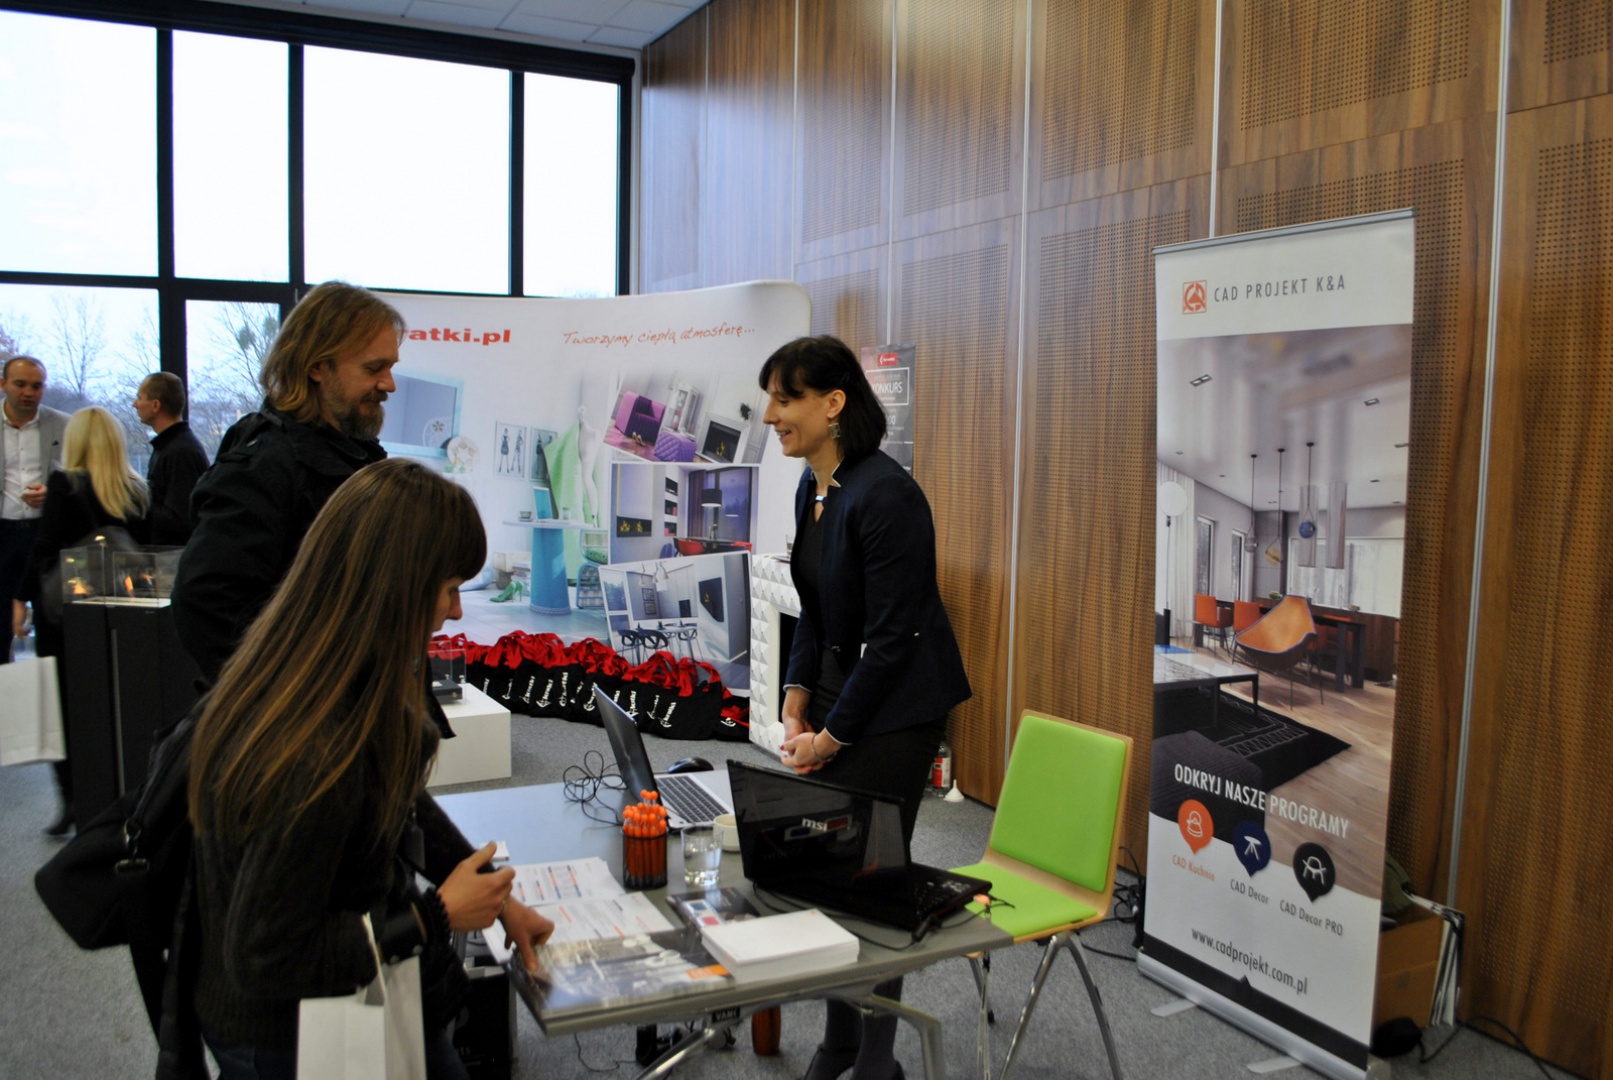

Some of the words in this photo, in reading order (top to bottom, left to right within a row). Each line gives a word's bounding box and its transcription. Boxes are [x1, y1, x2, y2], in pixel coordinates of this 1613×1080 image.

[1214, 286, 1238, 302] CAD
[1246, 278, 1308, 299] PROJEKT
[1316, 275, 1345, 292] K&A
[405, 328, 511, 346] atki.pl
[563, 331, 633, 348] Tworzymy
[1174, 763, 1221, 796] ODKRYJ
[1225, 780, 1266, 811] NASZE
[1269, 794, 1349, 839] PROGRAMY
[802, 817, 828, 832] msi
[1172, 854, 1186, 869] CAD
[1230, 878, 1246, 895] CAD
[1248, 885, 1269, 905] Decor
[1279, 899, 1296, 917] CAD
[1299, 909, 1322, 929] Decor
[1325, 918, 1343, 937] PRO
[1191, 927, 1308, 996] www.cadprojekt.com.pl
